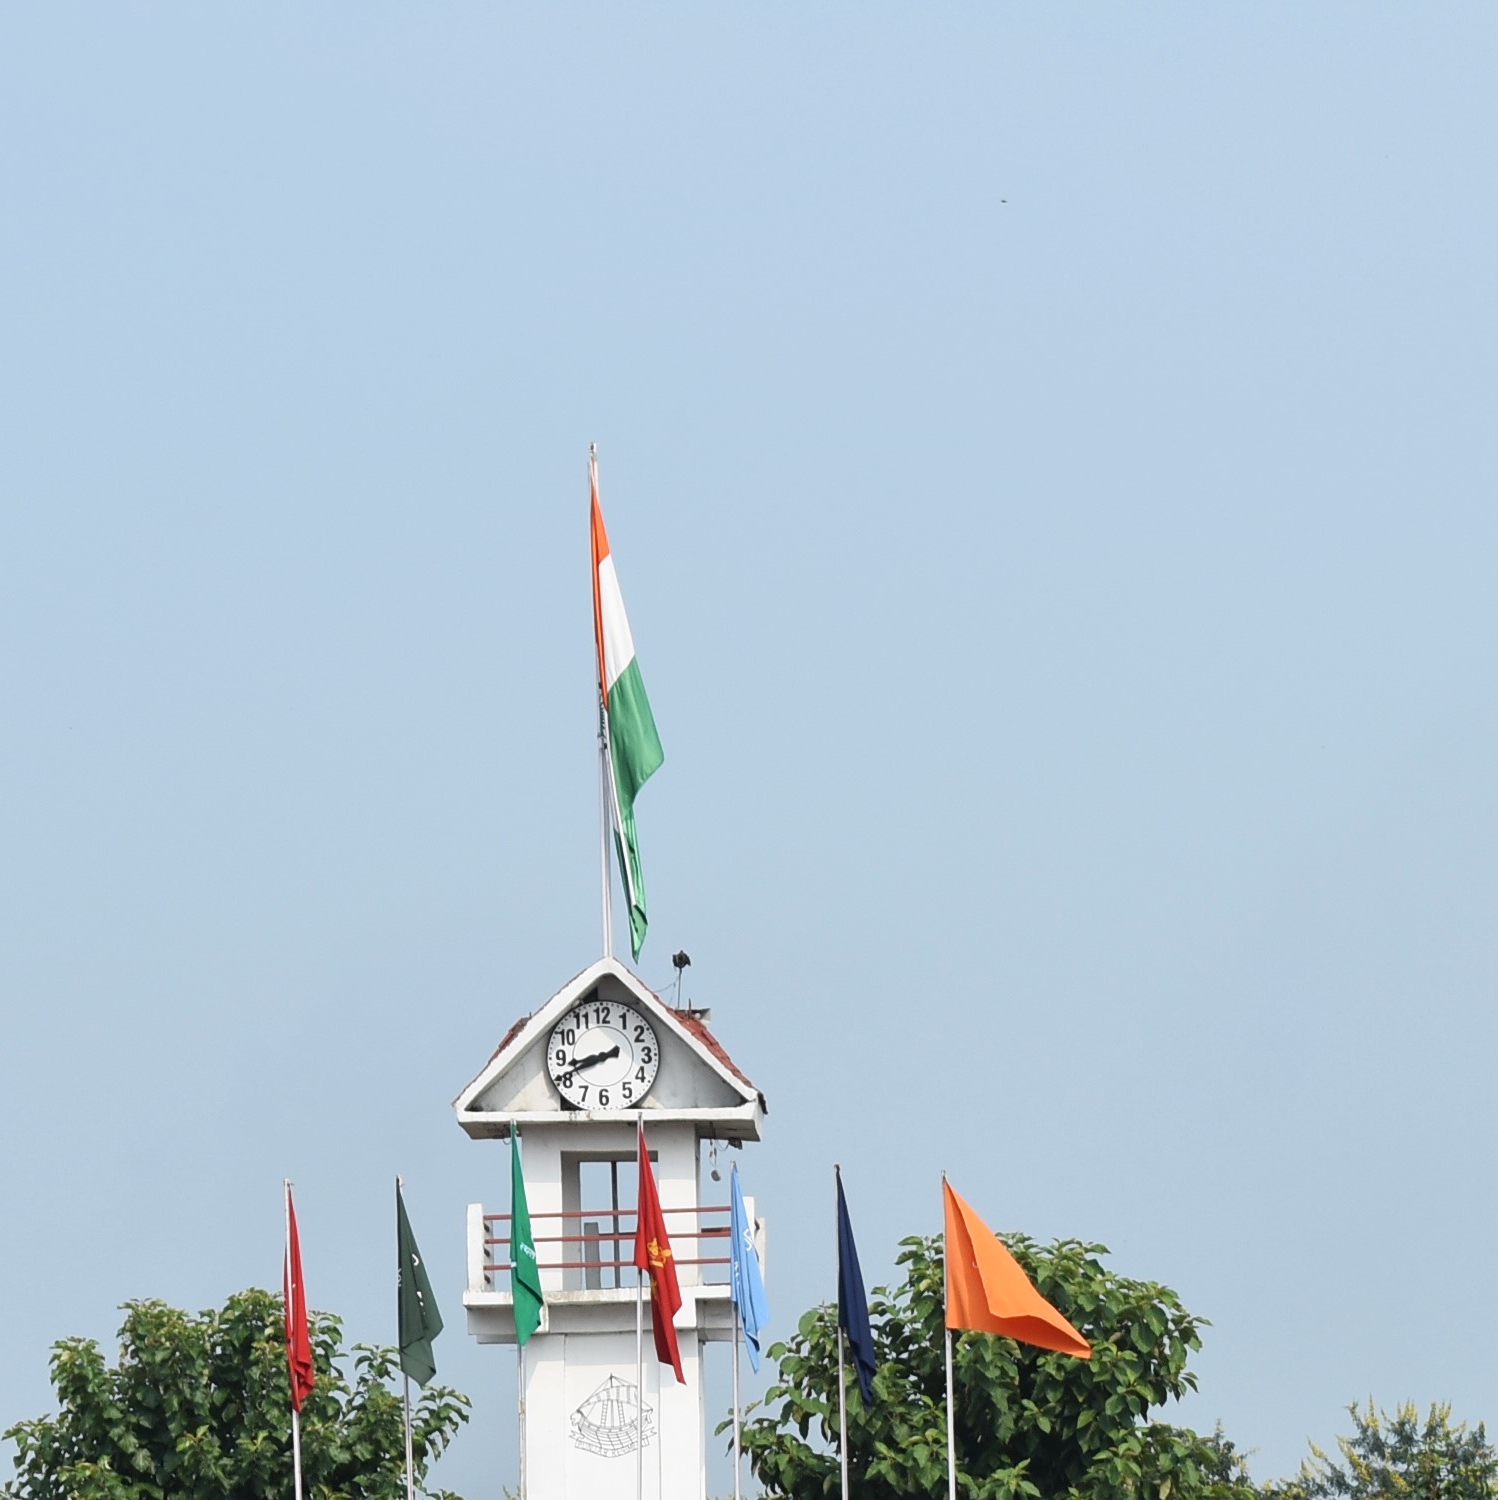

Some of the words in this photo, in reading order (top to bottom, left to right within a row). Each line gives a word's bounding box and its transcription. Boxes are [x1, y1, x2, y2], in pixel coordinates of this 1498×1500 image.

[573, 1011, 589, 1030] 11
[593, 1006, 611, 1024] 12
[619, 1012, 627, 1030] 1
[559, 1028, 575, 1046] 10
[633, 1025, 645, 1043] 2
[555, 1049, 566, 1066] 9
[641, 1046, 652, 1064] 3
[562, 1071, 573, 1089] 8
[635, 1066, 646, 1083] 4
[578, 1085, 589, 1102] 7
[599, 1089, 609, 1106] 6
[622, 1082, 632, 1099] 5
